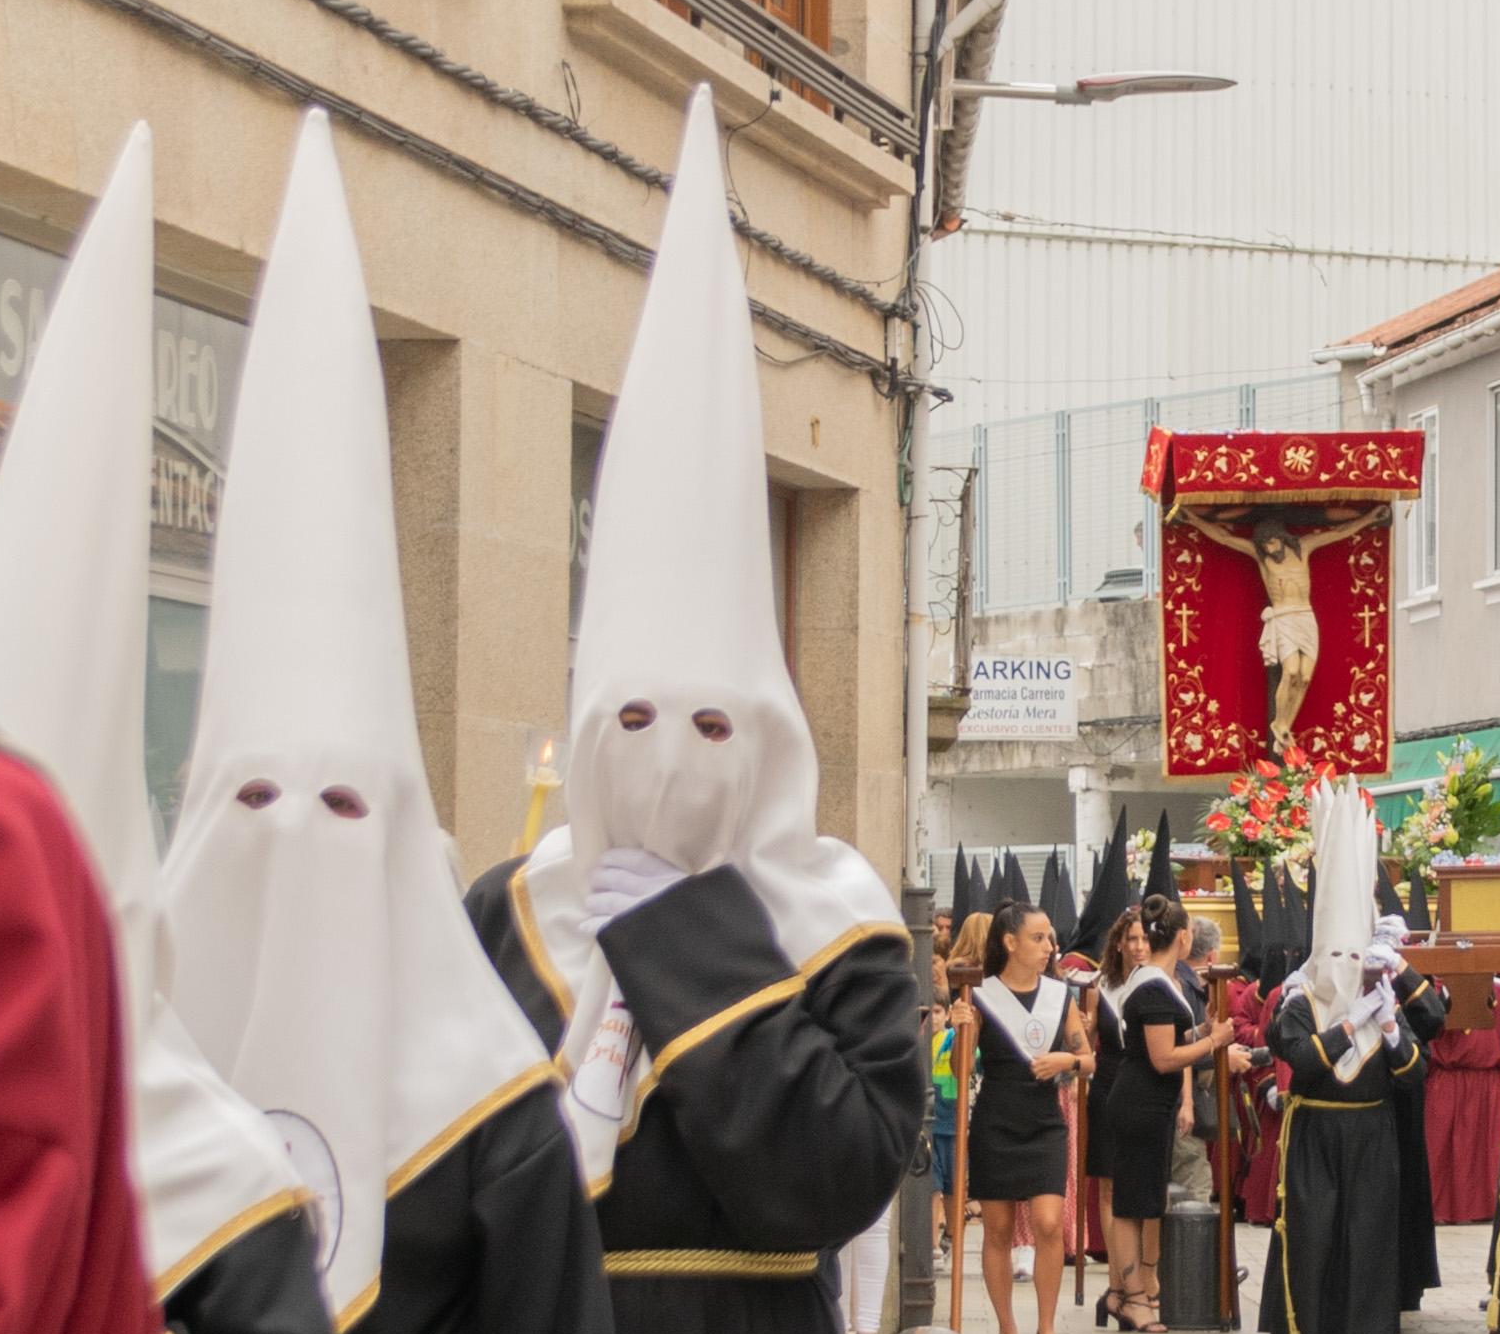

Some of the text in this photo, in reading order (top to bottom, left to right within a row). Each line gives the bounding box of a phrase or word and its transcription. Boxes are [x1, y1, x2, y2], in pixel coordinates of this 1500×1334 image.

[972, 660, 1072, 680] ARKING
[972, 686, 1065, 701] armacia Carreiro
[1023, 705, 1057, 719] Mera
[1022, 724, 1072, 734] CLIENTES
